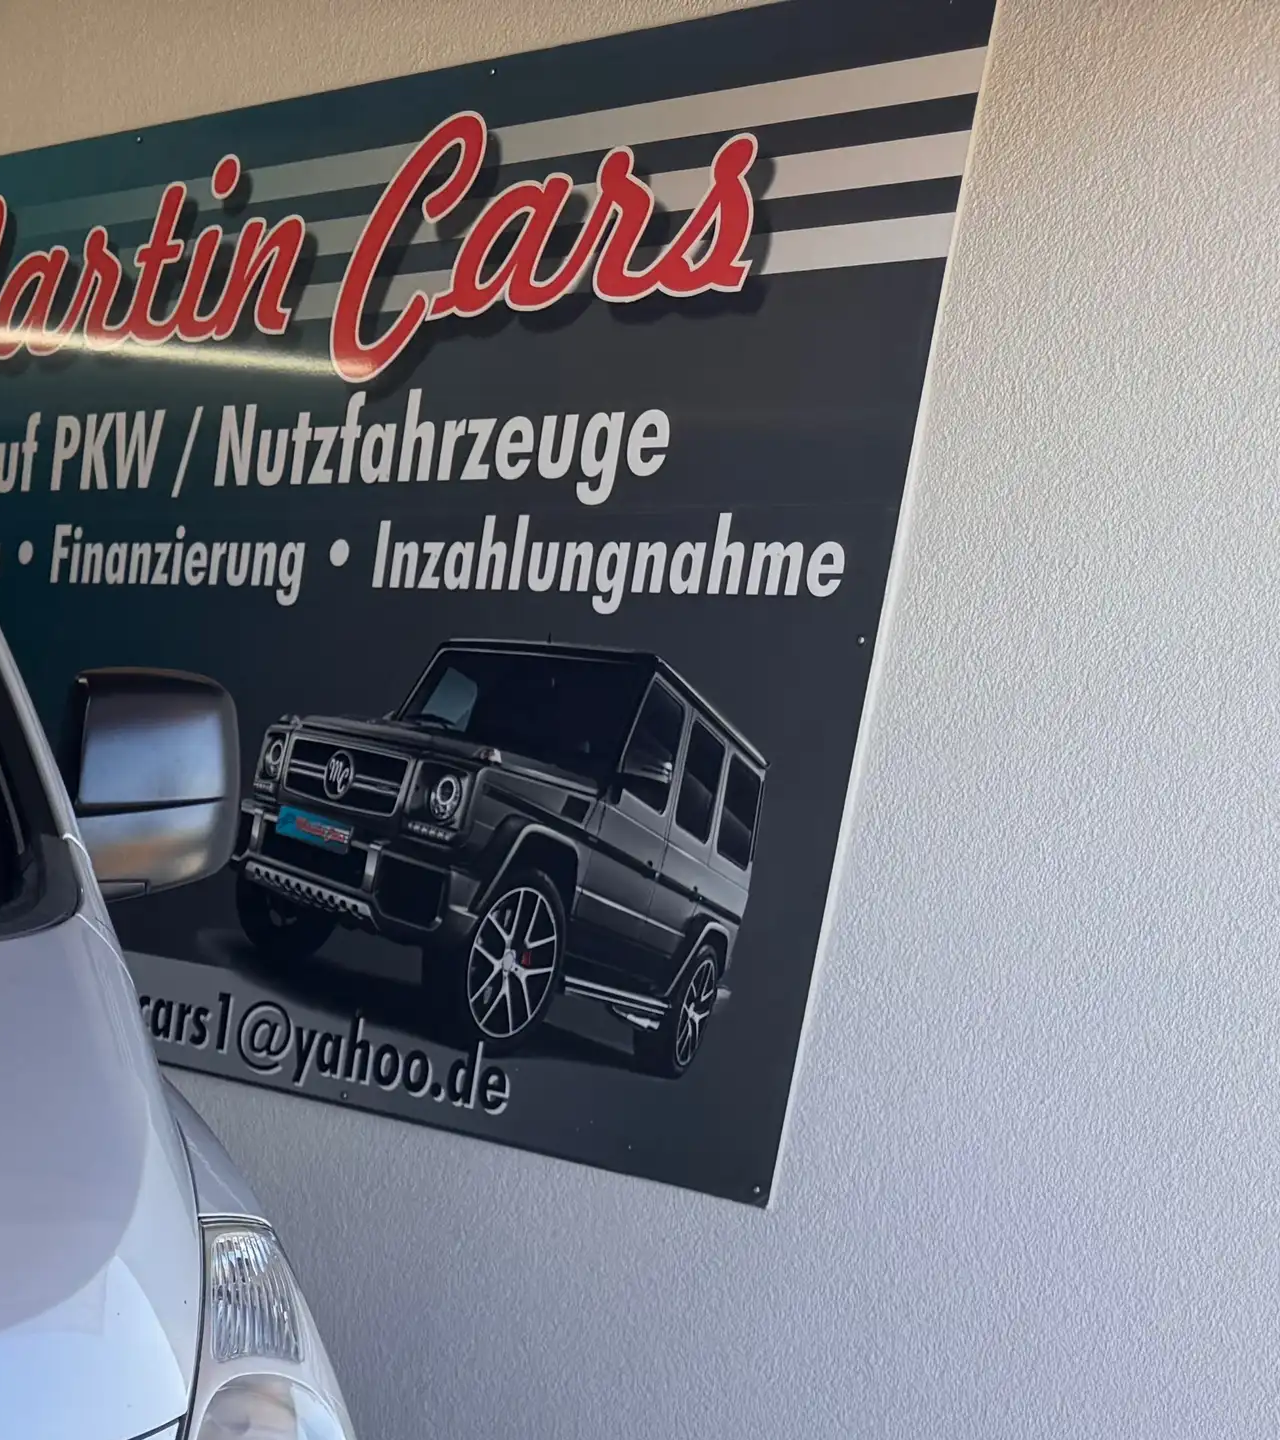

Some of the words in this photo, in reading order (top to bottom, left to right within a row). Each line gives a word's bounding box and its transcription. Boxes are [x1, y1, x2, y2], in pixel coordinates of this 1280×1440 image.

[329, 110, 758, 383] Cars
[51, 408, 166, 492] PKW
[171, 406, 203, 498] /
[213, 389, 671, 505] Nutzfahrzeuge
[49, 523, 307, 606] Finanzierung
[371, 512, 845, 615] Inzahlungnahme
